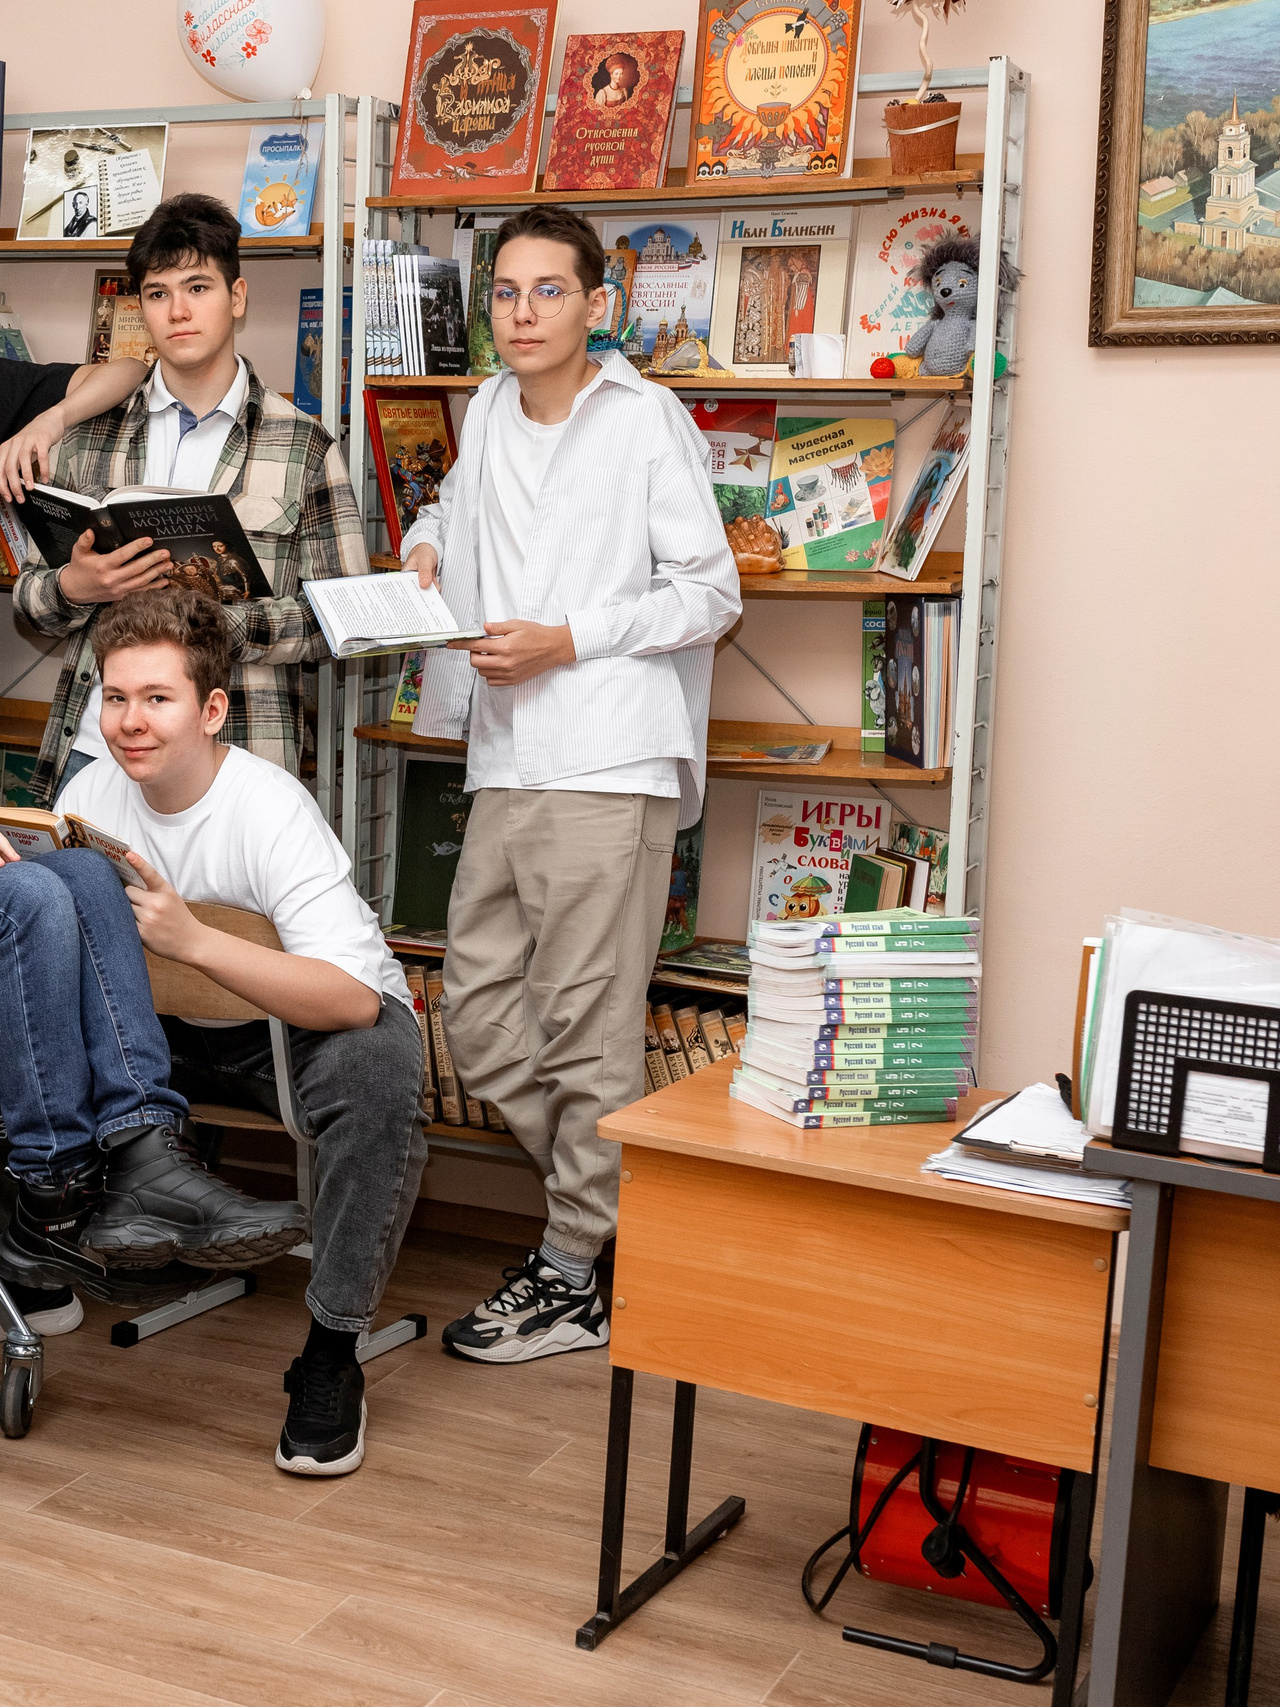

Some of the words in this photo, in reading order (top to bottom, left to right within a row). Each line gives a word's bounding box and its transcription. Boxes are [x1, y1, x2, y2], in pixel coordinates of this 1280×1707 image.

[210, 10, 258, 52] классная
[878, 228, 899, 263] ВСЮ
[897, 207, 947, 229] ЖИЗНЬ
[631, 299, 675, 308] РОССИИ
[868, 283, 900, 324] СЕРГЕЙ
[382, 407, 412, 418] СВЯТЫЕ
[413, 408, 440, 419] ВОИНЫ
[791, 429, 845, 451] Чудесная
[788, 439, 855, 466] мастерская
[128, 504, 215, 519] ВЕЛИЧАЙШИЕ
[132, 511, 219, 529] МОНАРХИ
[155, 523, 207, 536] МИРА
[801, 800, 882, 829] ИГРЫ
[12, 831, 40, 842] ПОЗНАЮ
[18, 838, 33, 847] МИР
[104, 849, 122, 863] МИР
[797, 854, 850, 871] слова
[851, 923, 870, 932] Русский
[871, 923, 884, 931] язык
[900, 923, 913, 931] 5
[845, 940, 865, 949] Русский
[866, 940, 879, 948] язык
[852, 980, 871, 989] Русский
[852, 996, 871, 1005] Русский
[899, 996, 912, 1004] 5
[854, 1011, 873, 1020] Русский
[901, 1011, 913, 1019] 5
[848, 1026, 867, 1035] Русский
[896, 1026, 909, 1034] 5
[432, 1019, 446, 1077] ШКОЛЬНАЯ
[844, 1042, 863, 1051] Русский
[844, 1057, 864, 1067] Русский
[892, 1057, 906, 1065] 5
[836, 1072, 855, 1081] Русский
[839, 1088, 858, 1097] Русский
[859, 1088, 872, 1096] язык
[888, 1088, 901, 1096] 5
[823, 1099, 843, 1109] Русский
[844, 1100, 857, 1108] язык
[873, 1100, 887, 1108] 5
[833, 1115, 852, 1124] Русский
[879, 1114, 892, 1122] 5
[45, 1224, 59, 1233] TIME
[59, 1219, 77, 1230] JUMP
